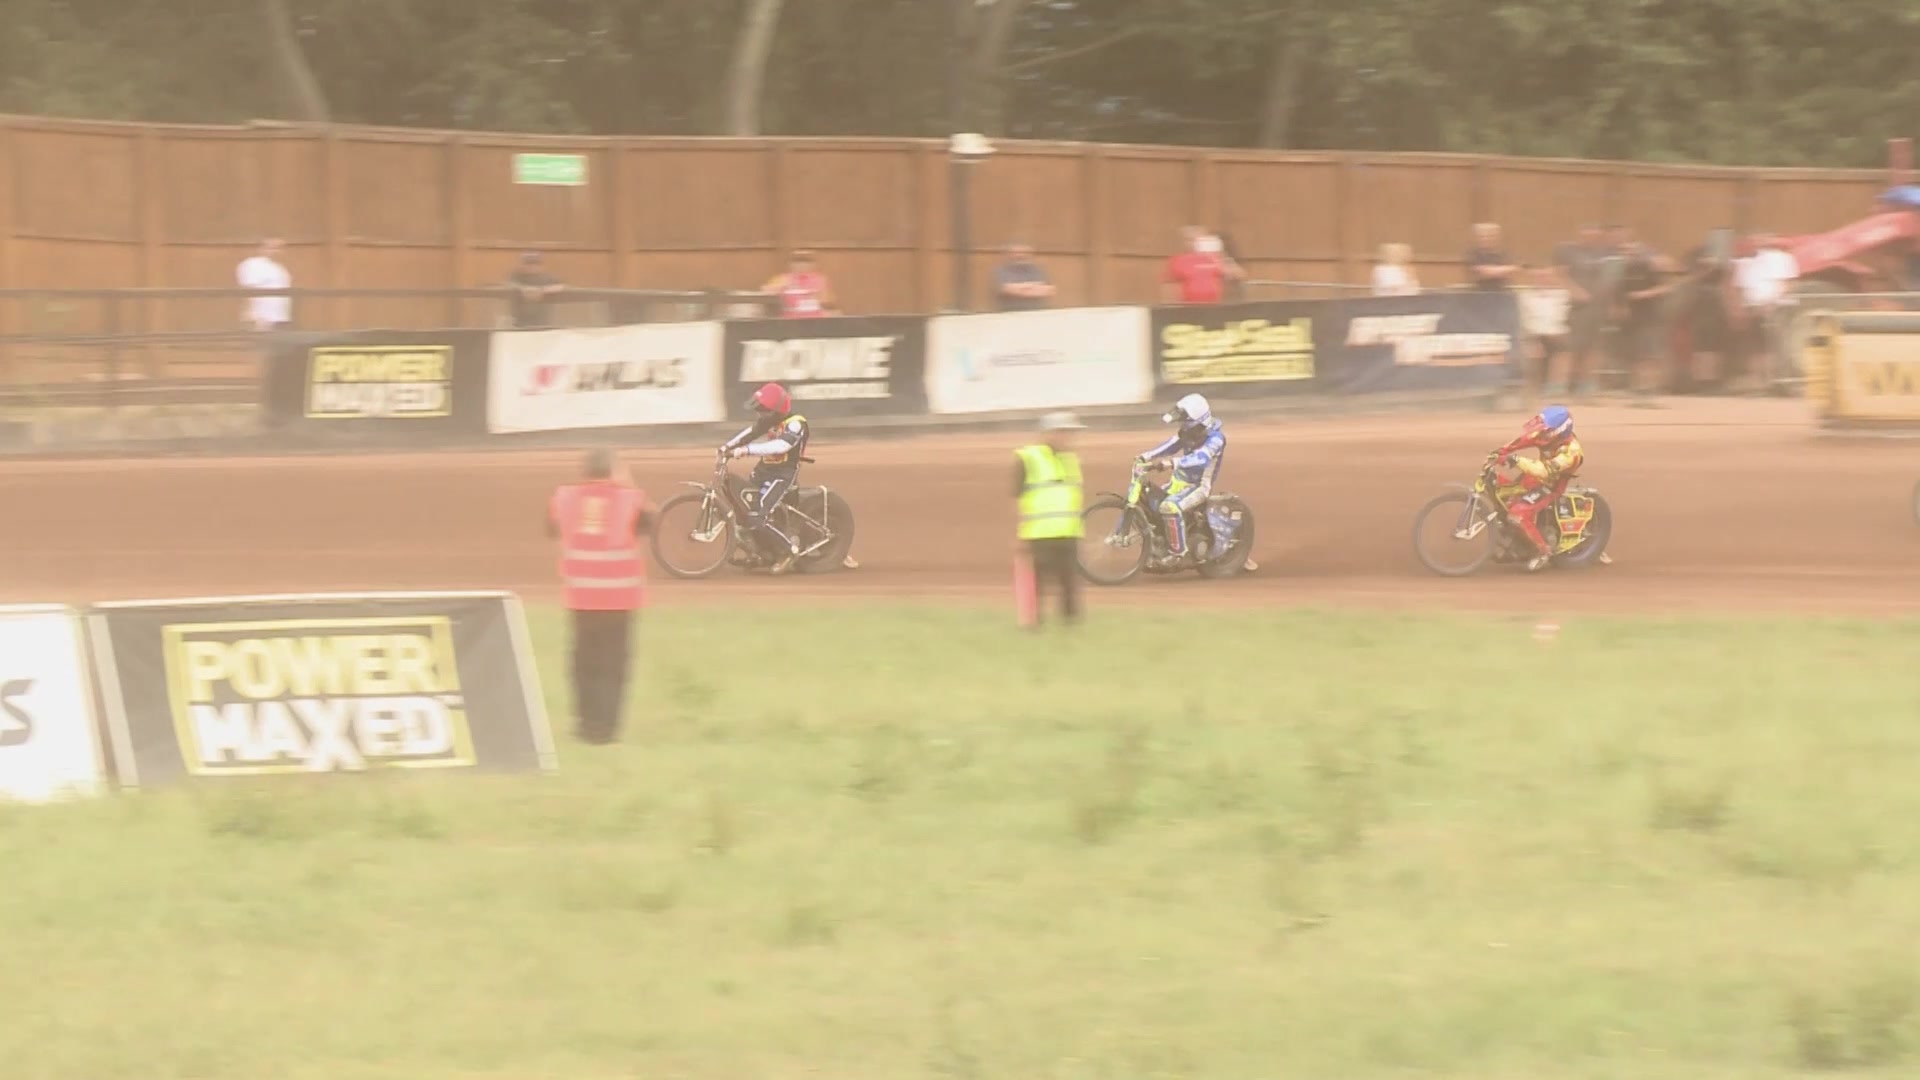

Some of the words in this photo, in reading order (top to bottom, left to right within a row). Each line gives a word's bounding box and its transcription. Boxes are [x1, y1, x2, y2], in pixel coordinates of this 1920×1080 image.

[315, 351, 446, 381] POWER
[185, 634, 440, 702] POWER
[187, 697, 454, 772] MAXED
